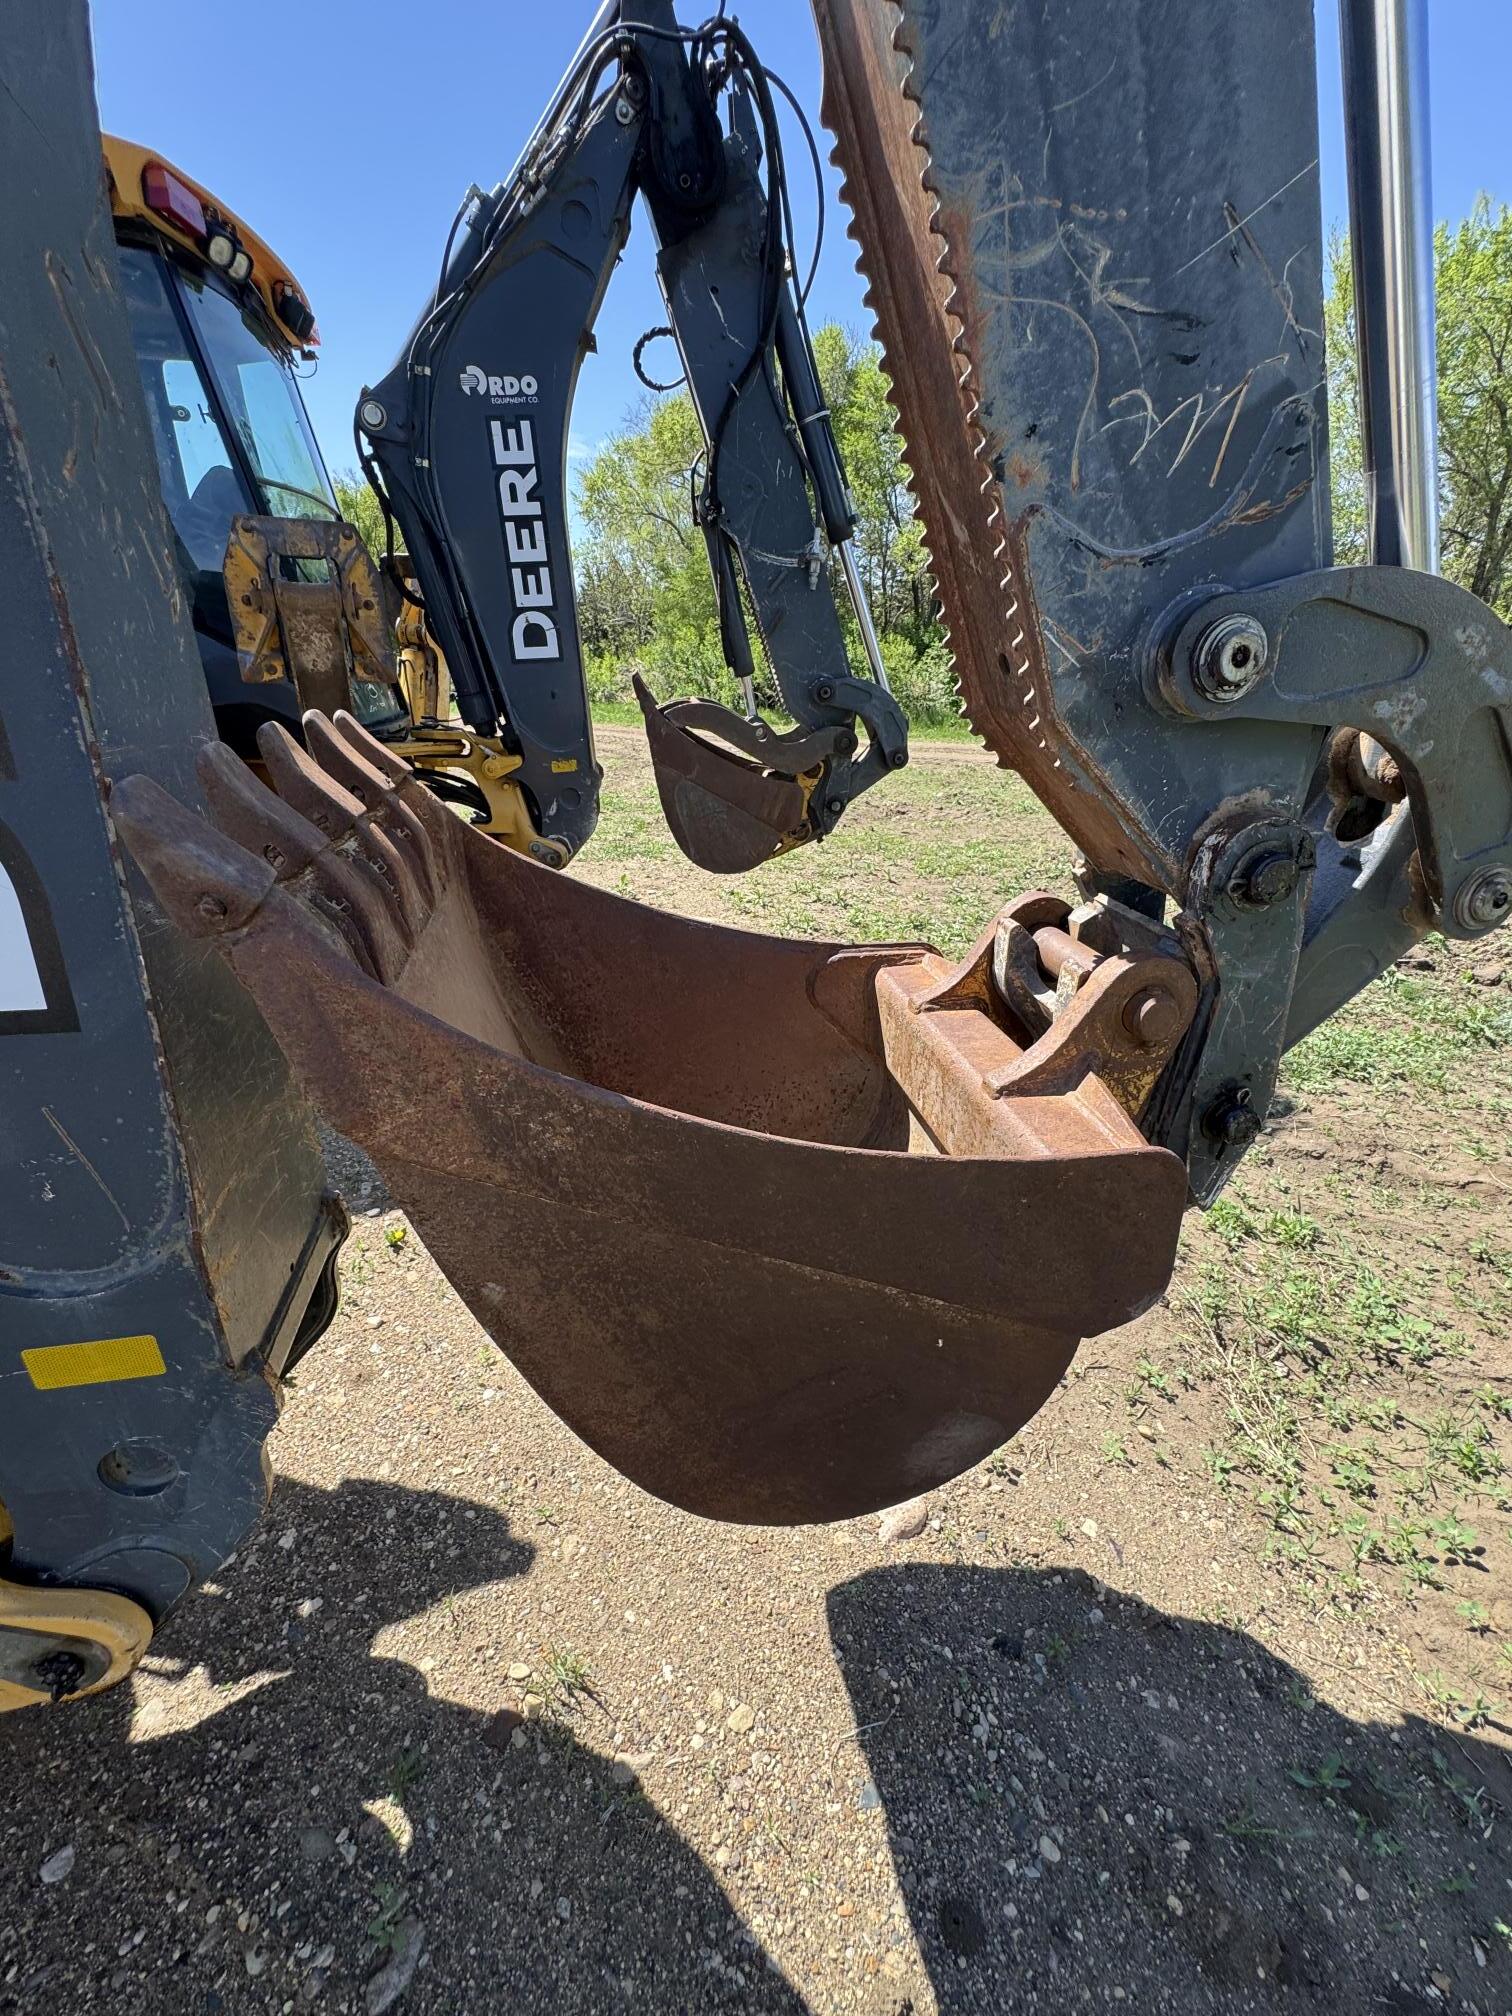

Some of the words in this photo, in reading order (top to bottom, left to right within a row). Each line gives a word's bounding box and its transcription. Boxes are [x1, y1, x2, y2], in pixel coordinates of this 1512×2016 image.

[487, 375, 538, 396] RDO
[490, 396, 526, 404] EQUIPMENT
[490, 420, 560, 660] DEERE
